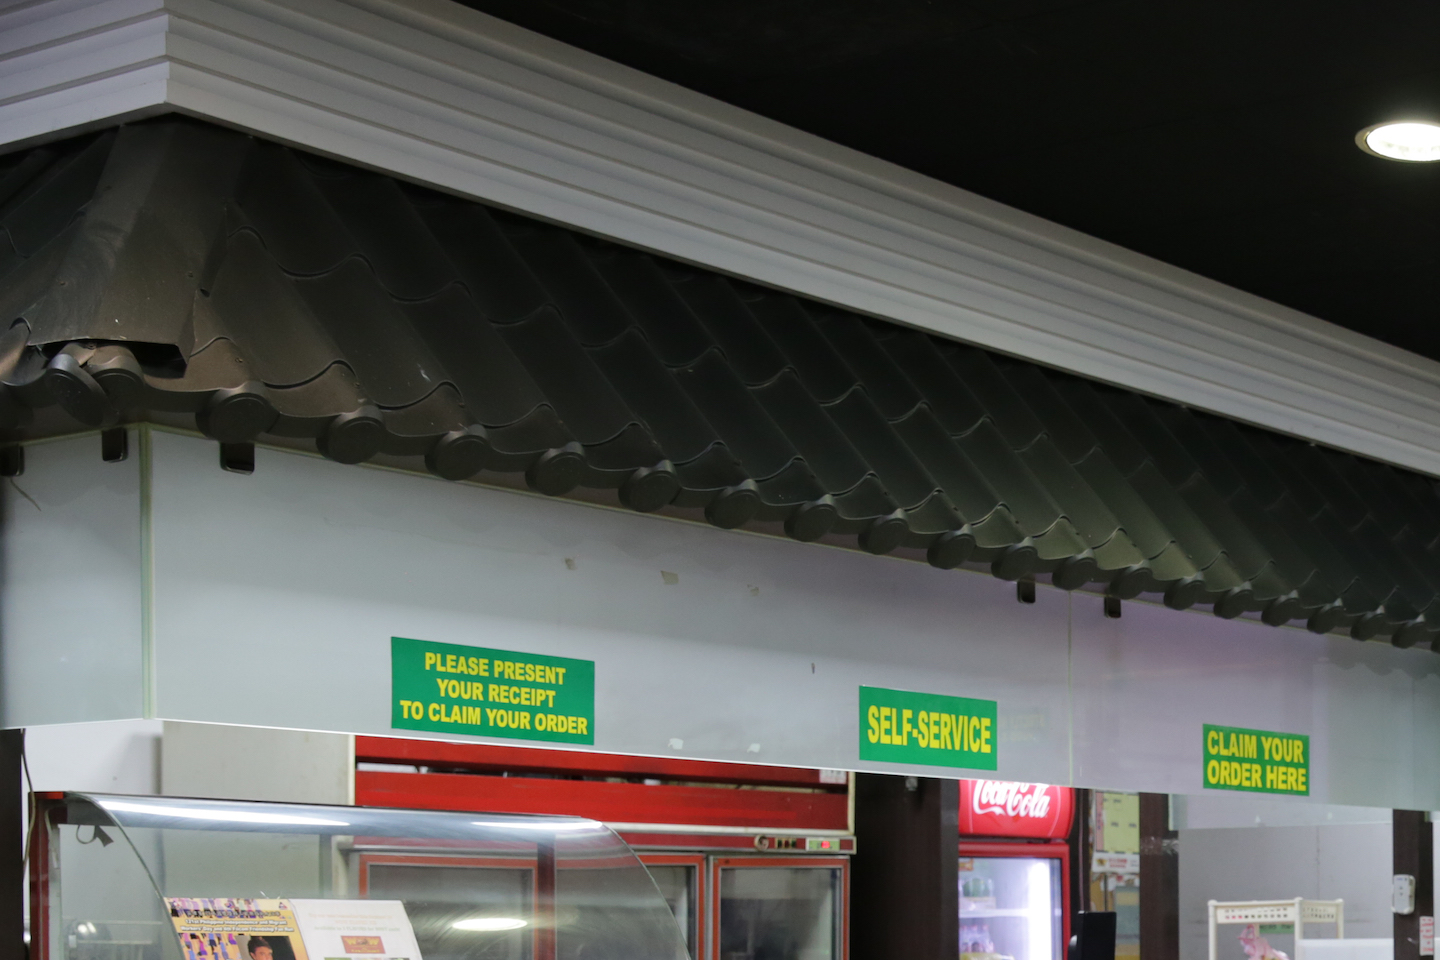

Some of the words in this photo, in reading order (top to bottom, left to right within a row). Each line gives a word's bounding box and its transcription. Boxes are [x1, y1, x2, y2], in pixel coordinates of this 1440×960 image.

[425, 652, 489, 677] PLEASE
[494, 660, 566, 685] PRESENT
[436, 678, 484, 701] YOUR
[488, 684, 556, 708] RECEIPT
[400, 700, 424, 720] TO
[428, 703, 481, 725] CLAIM
[486, 708, 531, 730] YOUR
[534, 712, 588, 735] ORDER
[867, 705, 992, 754] SELF-SERVICE
[1207, 730, 1257, 759] CLAIM
[1260, 736, 1304, 763] YOUR
[1206, 760, 1262, 788] ORDER
[1265, 764, 1307, 792] HERE
